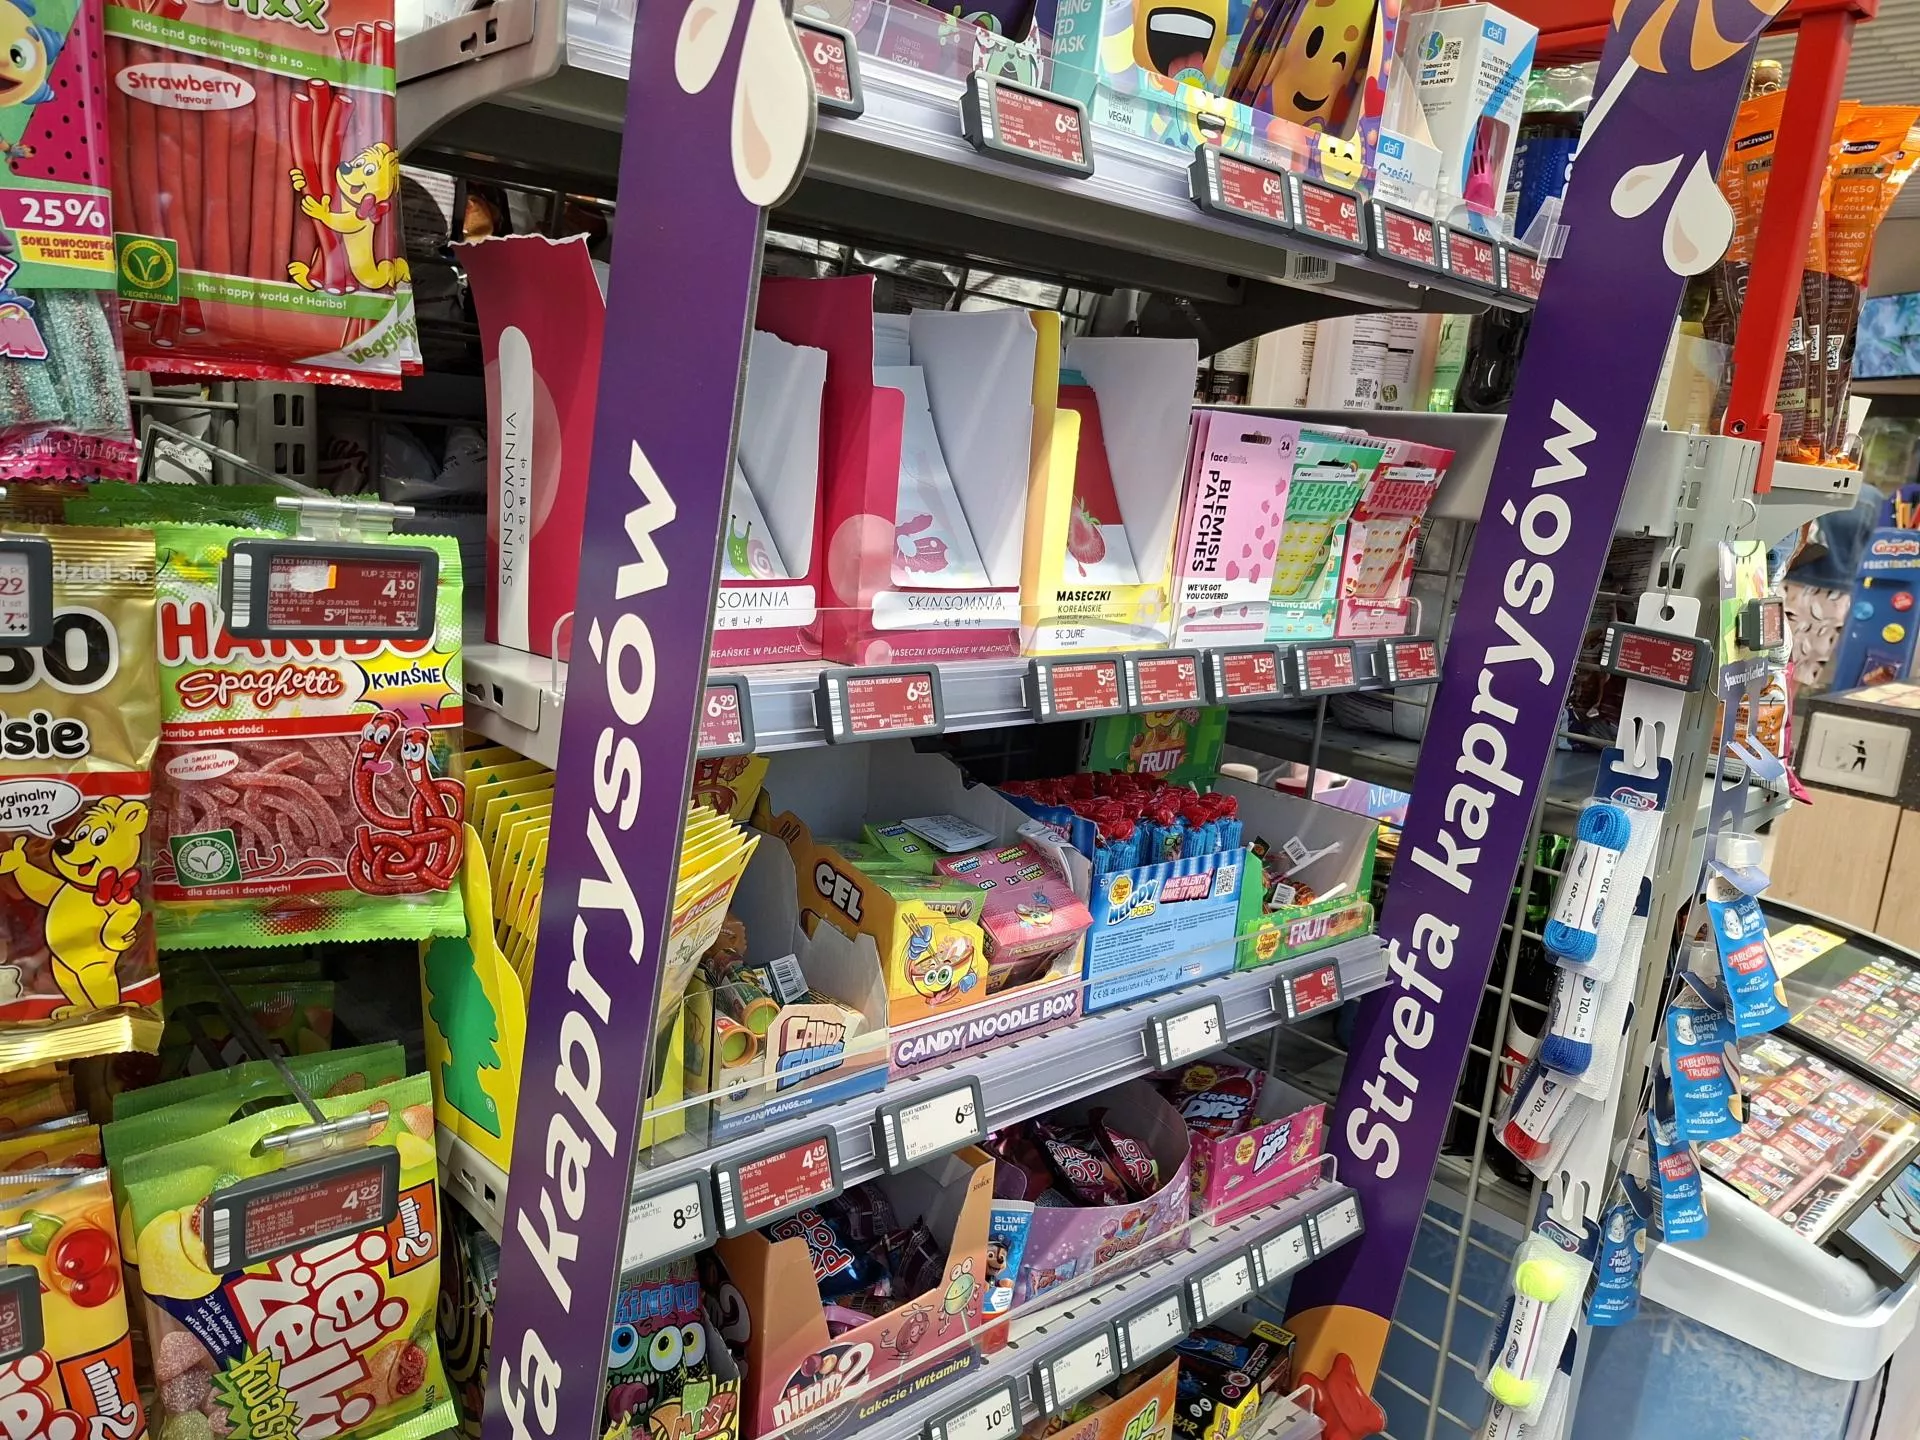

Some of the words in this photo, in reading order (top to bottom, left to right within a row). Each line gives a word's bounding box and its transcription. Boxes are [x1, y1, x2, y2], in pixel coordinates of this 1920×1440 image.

[1487, 25, 1503, 42] dafi
[131, 17, 158, 33] Kids
[162, 27, 185, 41] and
[189, 31, 250, 56] grown-ups
[254, 46, 276, 63] love
[280, 51, 289, 65] it
[291, 57, 303, 69] so
[126, 71, 243, 98] Strawberry
[1428, 77, 1455, 86] PLANETY
[174, 93, 213, 106] flavour
[1108, 109, 1132, 125] VEGAN
[1383, 140, 1400, 157] dafi
[1736, 133, 1774, 150] TARCZYŃSKI
[1844, 142, 1878, 153] TARCZYŃSKI
[1747, 162, 1760, 172] CZY
[1841, 167, 1852, 175] CZY
[1840, 184, 1876, 194] MIĘSO
[1845, 195, 1865, 204] JEST
[20, 197, 106, 229] 25%
[1834, 212, 1867, 221] BIAŁKA
[21, 235, 51, 247] SOKU
[1828, 230, 1866, 240] BIAŁKO
[40, 247, 70, 260] FRUIT
[73, 249, 105, 261] JUICE
[122, 289, 174, 302] VEGETARIAN
[197, 281, 217, 296] the
[219, 283, 255, 305] happy
[258, 289, 291, 305] world
[293, 292, 304, 307] of
[306, 295, 347, 311] Haribo!
[1280, 441, 1291, 451] 24
[1297, 446, 1307, 456] 24
[1386, 446, 1397, 455] 24
[1375, 480, 1433, 495] BLEMISH
[502, 411, 518, 588] SKINSOMNIA
[1286, 499, 1349, 513] ATCHES
[1371, 498, 1427, 512] PATCHES
[1191, 468, 1222, 572] PATCHES
[1204, 479, 1232, 573] BLEMISH
[119, 566, 148, 585] się
[361, 569, 377, 579] KUP
[1188, 584, 1207, 592] WE'VE
[906, 595, 1003, 611] SKINSOMNIA
[1056, 590, 1112, 602] MASECZKI
[1186, 592, 1200, 600] YOU
[1200, 592, 1229, 600] COVERED
[1057, 603, 1102, 614] KOREAŃSKIE
[753, 648, 762, 657] W
[763, 643, 803, 656] PŁACHCIE
[888, 647, 926, 658] MASECZKI
[927, 645, 969, 657] KOREAŃSKIE
[970, 645, 978, 655] W
[978, 643, 1011, 655] PŁACHCIE
[371, 662, 442, 691] KWAŚNE
[177, 665, 343, 709] Spaghetti
[198, 726, 225, 737] smak
[228, 724, 264, 735] radości
[191, 753, 218, 763] SMAKU
[1138, 750, 1182, 772] FRUIT
[168, 758, 236, 776] TRUSKAWKOWYM
[1346, 913, 1461, 1181] Strefa
[1410, 397, 1599, 897] kaprysów
[1618, 792, 1651, 808] TREND
[16, 804, 50, 818] 1922
[903, 845, 919, 854] GEL
[950, 856, 980, 870] POPPING
[517, 438, 679, 1313] kaprysów
[1017, 864, 1041, 877] CANDY
[1024, 871, 1044, 882] STICK
[187, 886, 203, 897] dla
[205, 886, 234, 897] dzieci
[242, 883, 291, 896] dorosłych!
[980, 880, 996, 890] GEL
[1165, 878, 1179, 888] HAVE
[1600, 877, 1612, 894] 120
[815, 862, 864, 924] GEL
[1162, 888, 1180, 899] MAKE
[941, 903, 957, 913] BOX
[1108, 879, 1159, 925] MELODY
[1130, 904, 1155, 917] POPS
[1287, 919, 1330, 946] FRUIT
[1580, 996, 1592, 1015] 120
[780, 1015, 847, 1054] CANDY
[896, 1025, 966, 1065] CANDY
[968, 1005, 1041, 1041] NOODLE
[1042, 992, 1079, 1023] BOX
[1700, 1084, 1713, 1093] BEZ
[1198, 1092, 1249, 1105] CRAZY
[1533, 1097, 1546, 1114] 120
[1182, 1100, 1246, 1119] DIPS
[1263, 1121, 1291, 1145] CRAZY
[1254, 1129, 1290, 1173] DIPS
[994, 1215, 1027, 1225] SLIME
[396, 1197, 433, 1263] nimm2
[994, 1223, 1018, 1233] GUM
[204, 1293, 224, 1318] Żelki
[220, 1314, 243, 1346] owocowe
[1513, 1318, 1524, 1336] 120
[184, 1313, 225, 1356] witaminami
[773, 1341, 876, 1428] nimm2
[859, 1387, 908, 1420] Łakocie
[914, 1353, 972, 1393] Witaminy
[1125, 1400, 1158, 1440] BIG
